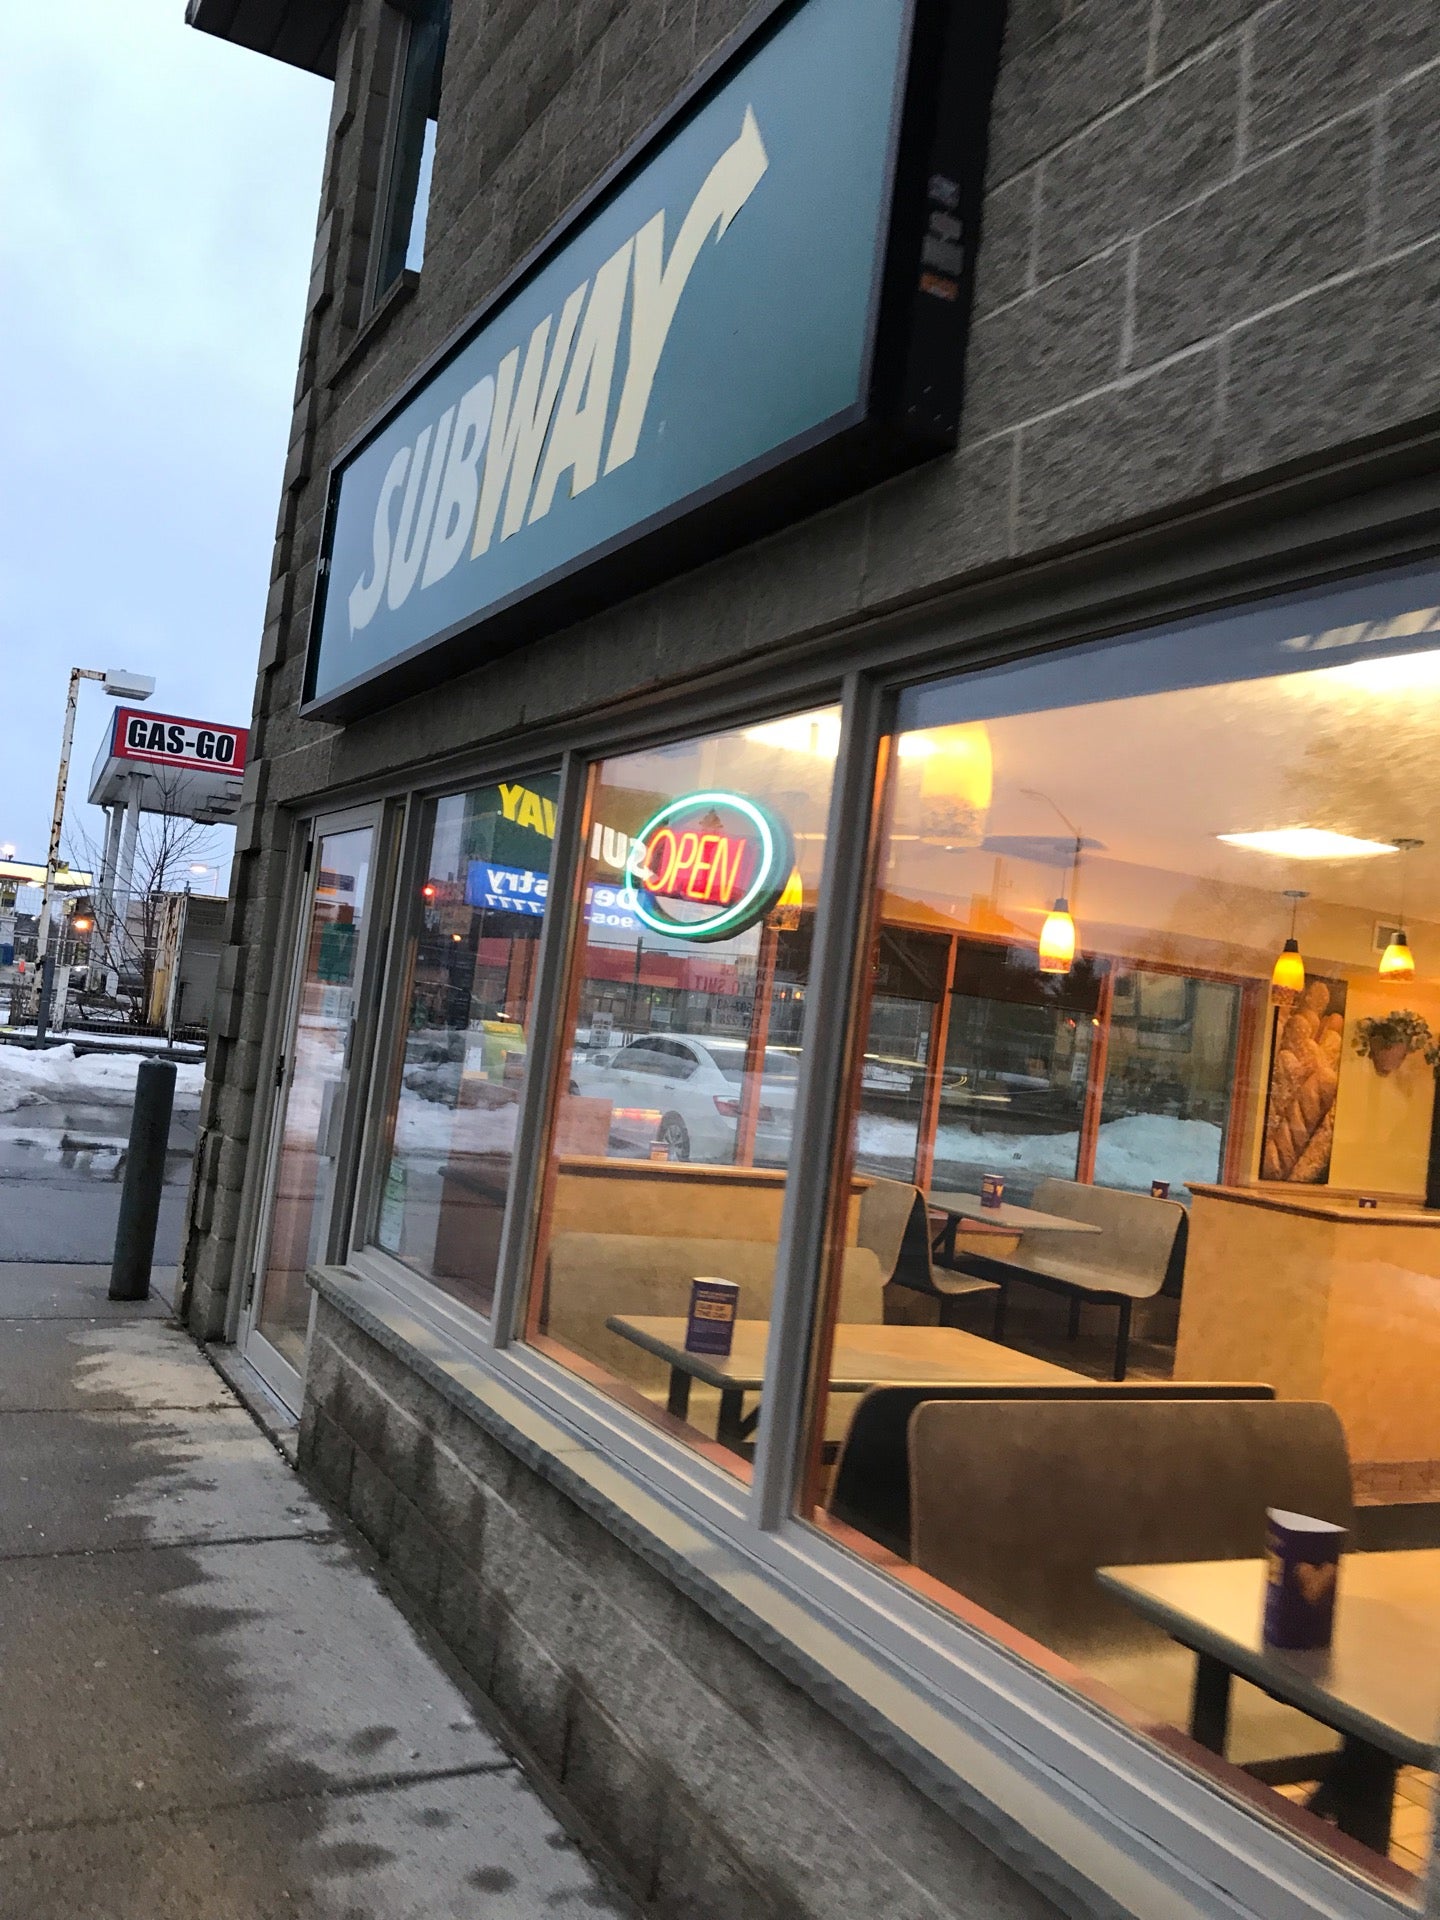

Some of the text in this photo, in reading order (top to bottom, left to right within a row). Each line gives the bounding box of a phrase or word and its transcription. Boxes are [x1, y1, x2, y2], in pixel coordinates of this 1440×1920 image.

[349, 103, 769, 641] SUBWAY
[127, 719, 237, 763] GAS-GO
[644, 828, 747, 904] OPEN
